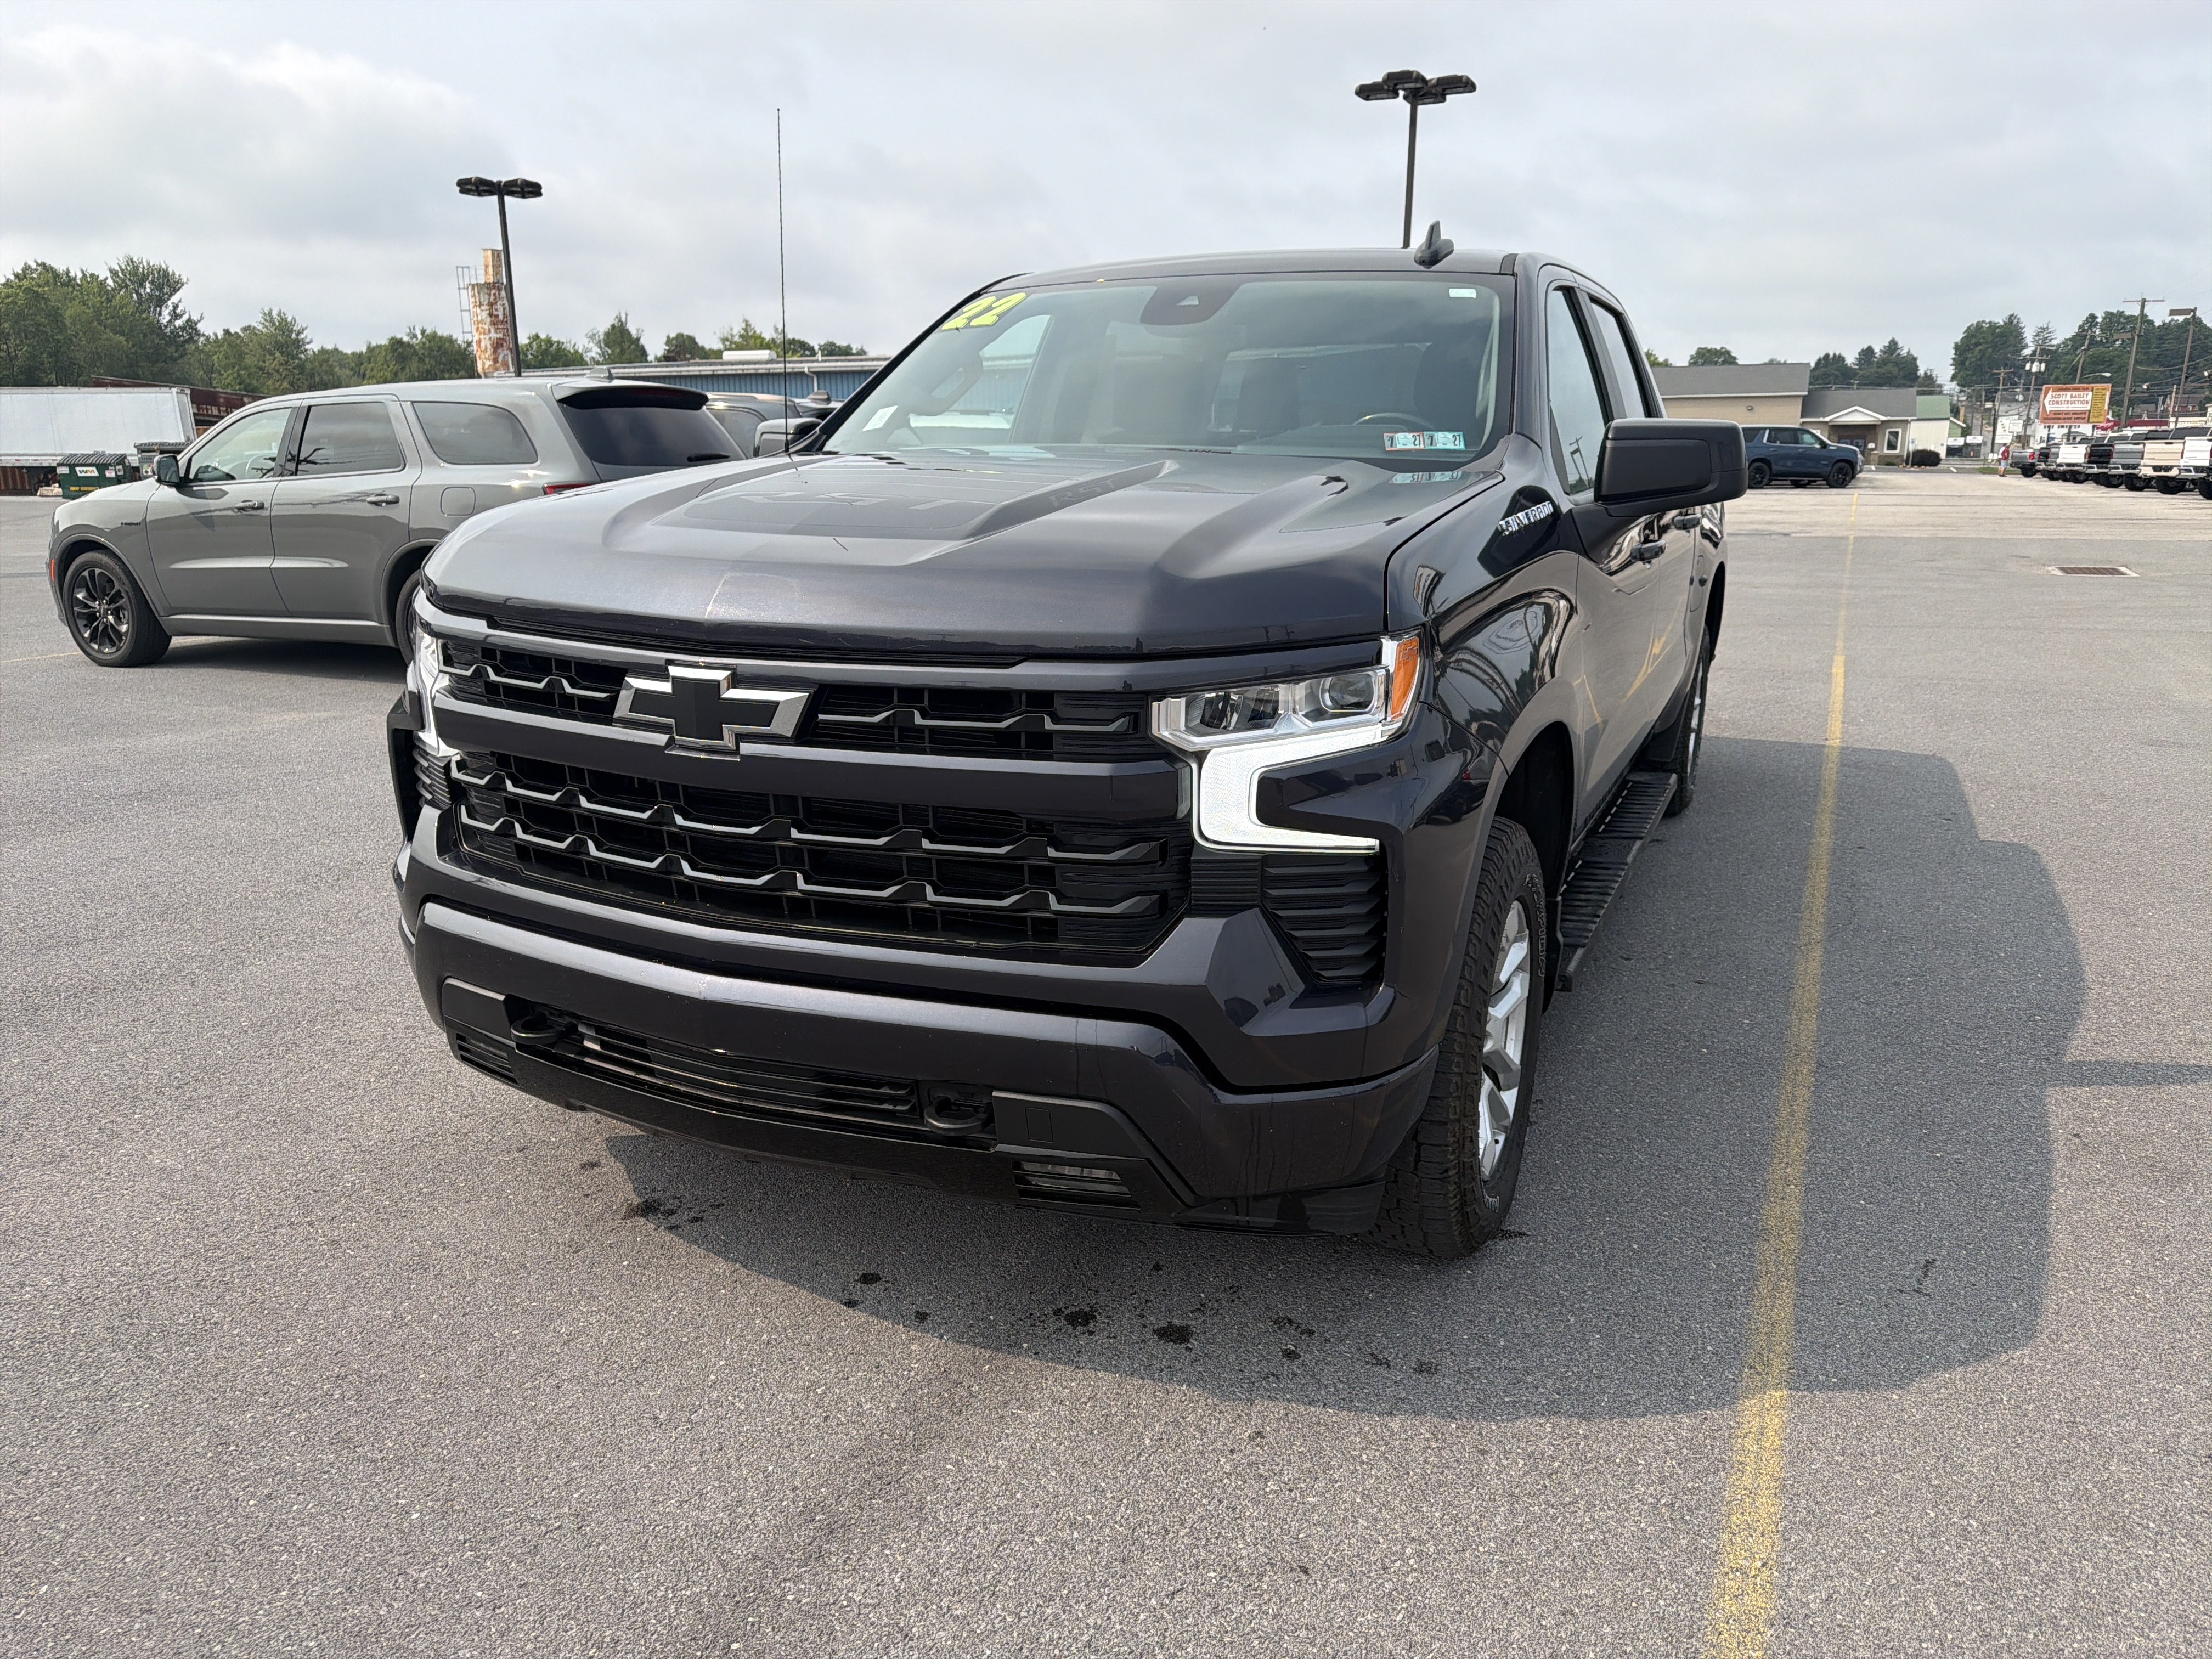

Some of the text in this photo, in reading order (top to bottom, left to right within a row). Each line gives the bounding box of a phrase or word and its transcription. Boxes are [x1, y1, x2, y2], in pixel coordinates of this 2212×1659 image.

[941, 292, 1027, 330] 22
[1412, 434, 1421, 447] 27
[1452, 434, 1461, 447] 27
[1049, 477, 1119, 507] RST
[1497, 500, 1554, 536] SILVERADO
